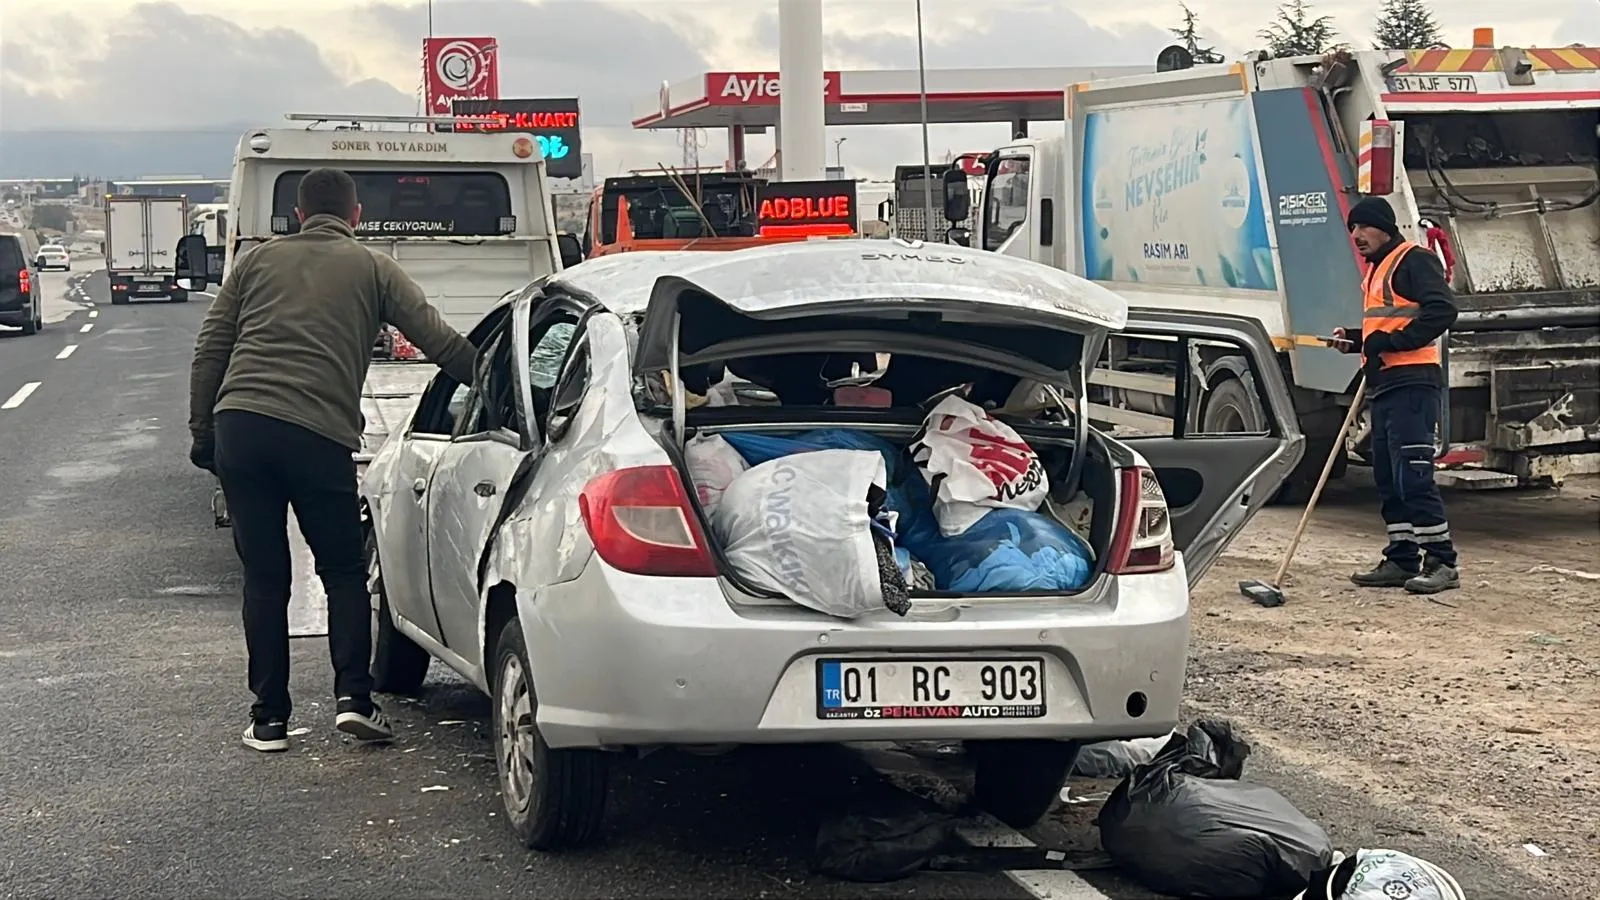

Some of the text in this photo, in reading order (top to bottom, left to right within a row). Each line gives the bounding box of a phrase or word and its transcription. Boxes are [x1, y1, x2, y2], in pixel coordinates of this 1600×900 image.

[721, 74, 830, 102] Aytez
[1395, 77, 1470, 91] 31 AJF 577
[331, 141, 448, 153] SONER YOLYARDIM
[759, 196, 849, 219] ADBLUE
[1144, 239, 1189, 259] RASİM ARI
[861, 253, 973, 264] SYMBO
[843, 664, 1038, 703] 01 RC 903
[825, 688, 840, 700] TR
[863, 707, 881, 719] ÖZ
[882, 706, 960, 718] PEHLİVAN
[961, 705, 1000, 718] AUTO
